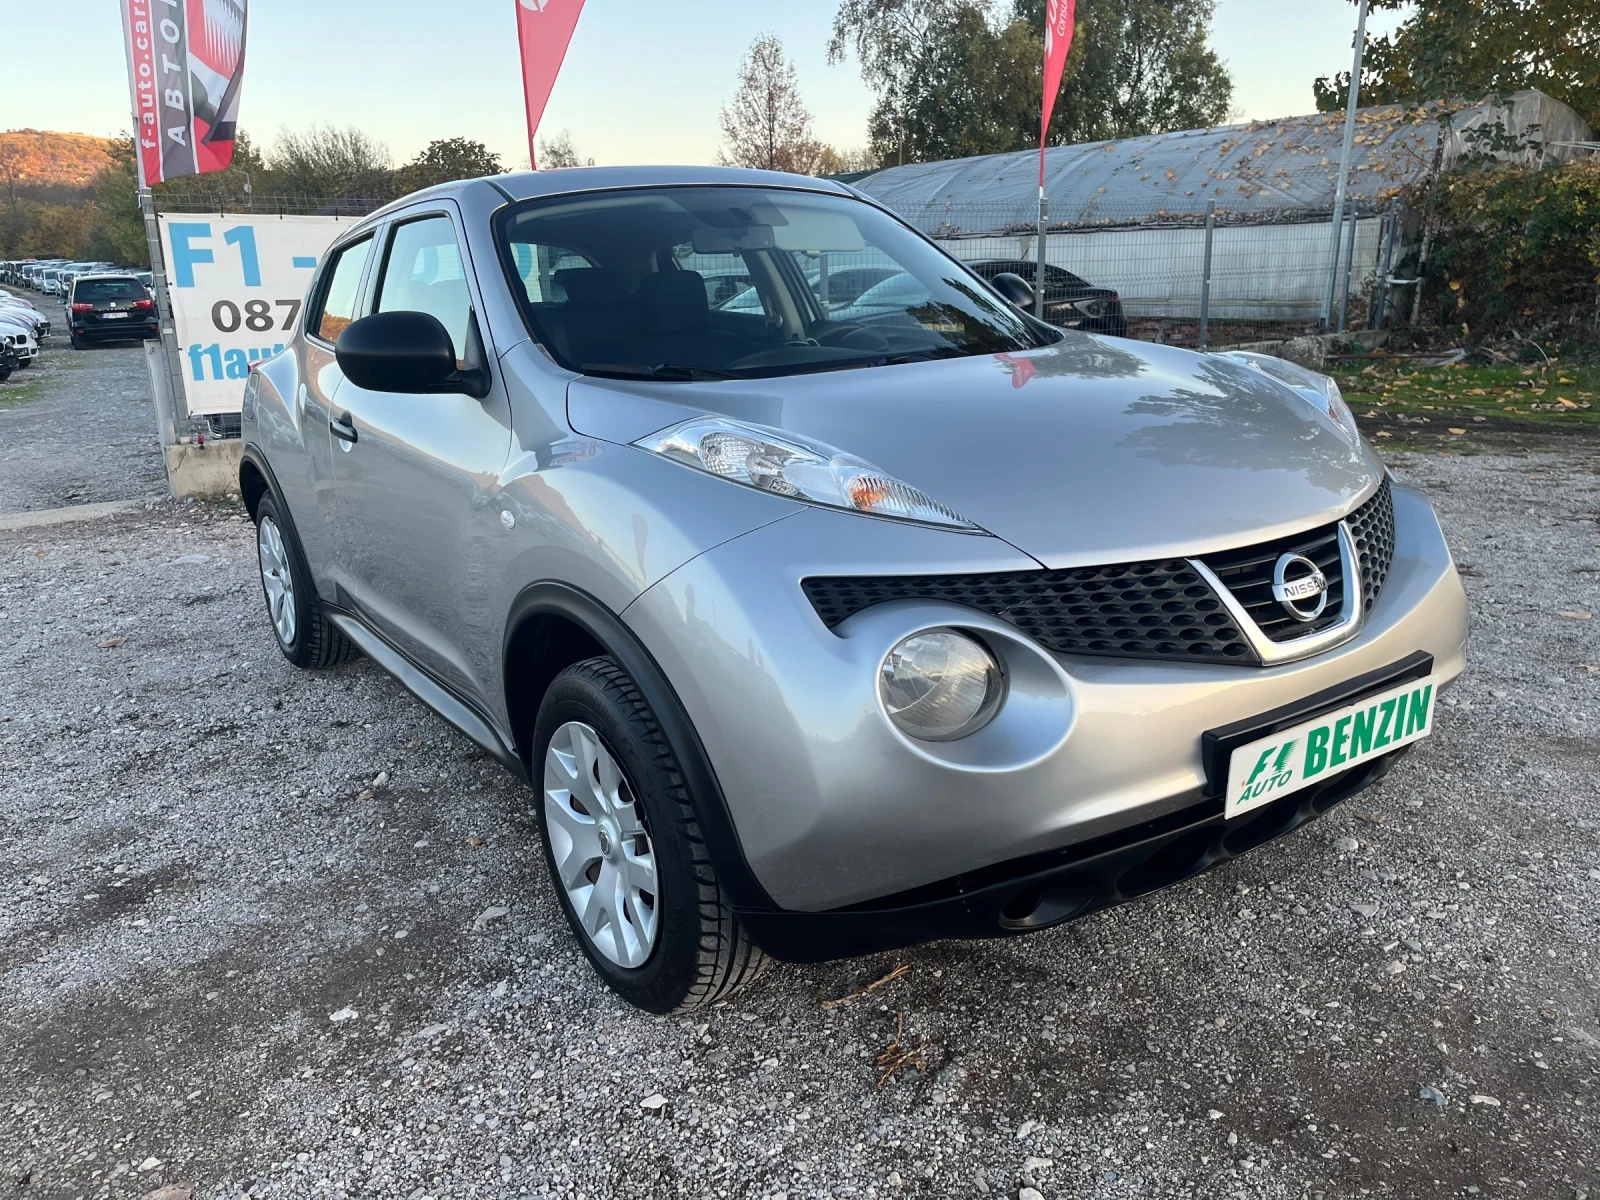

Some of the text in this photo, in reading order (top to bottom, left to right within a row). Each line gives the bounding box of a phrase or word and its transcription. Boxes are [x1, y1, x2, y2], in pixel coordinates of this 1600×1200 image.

[1057, 0, 1068, 37] Consu
[168, 222, 262, 288] F1
[211, 299, 302, 333] 087
[1283, 575, 1326, 598] NISSAN
[1302, 683, 1433, 781] BENZIN
[1236, 769, 1293, 805] AUTO
